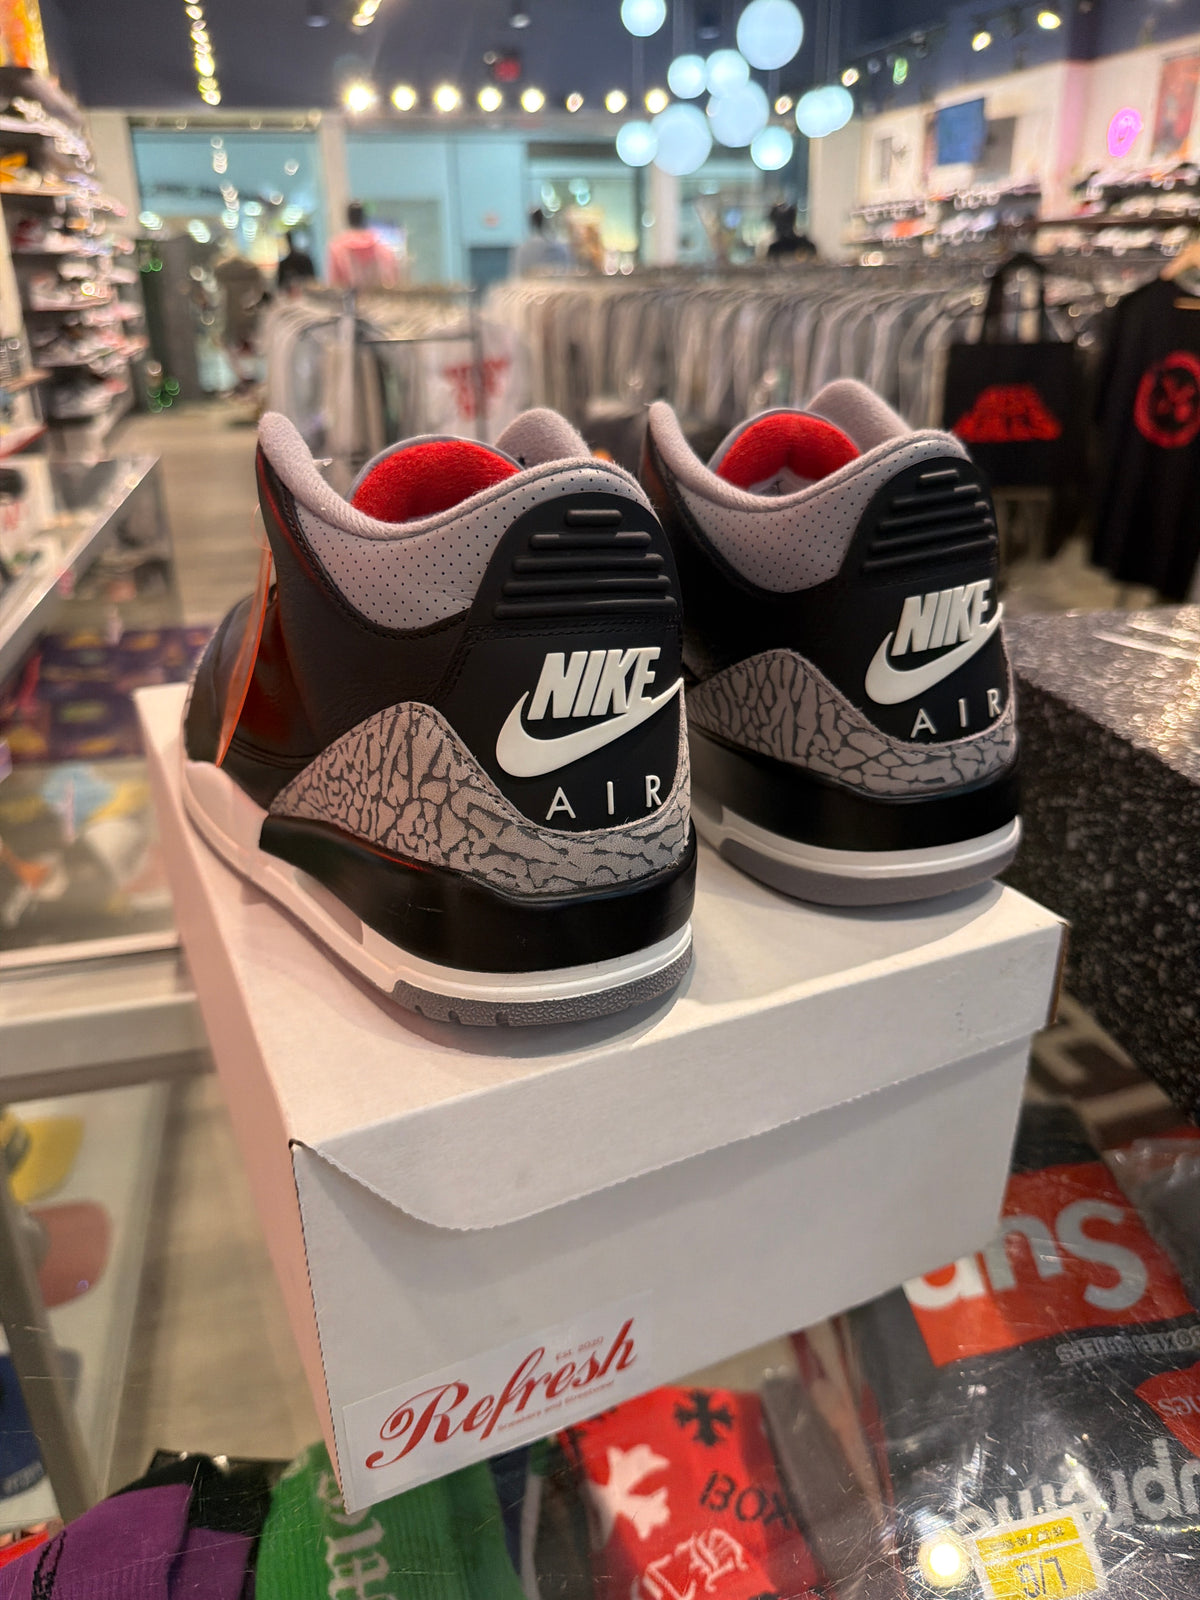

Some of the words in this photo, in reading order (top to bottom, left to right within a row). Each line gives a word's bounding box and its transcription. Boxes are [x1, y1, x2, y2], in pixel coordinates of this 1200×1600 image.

[890, 578, 992, 657] NIKE
[527, 647, 661, 720] NIKE
[910, 688, 1001, 738] AIR
[546, 775, 662, 820] AIR
[365, 1317, 638, 1469] Refresh
